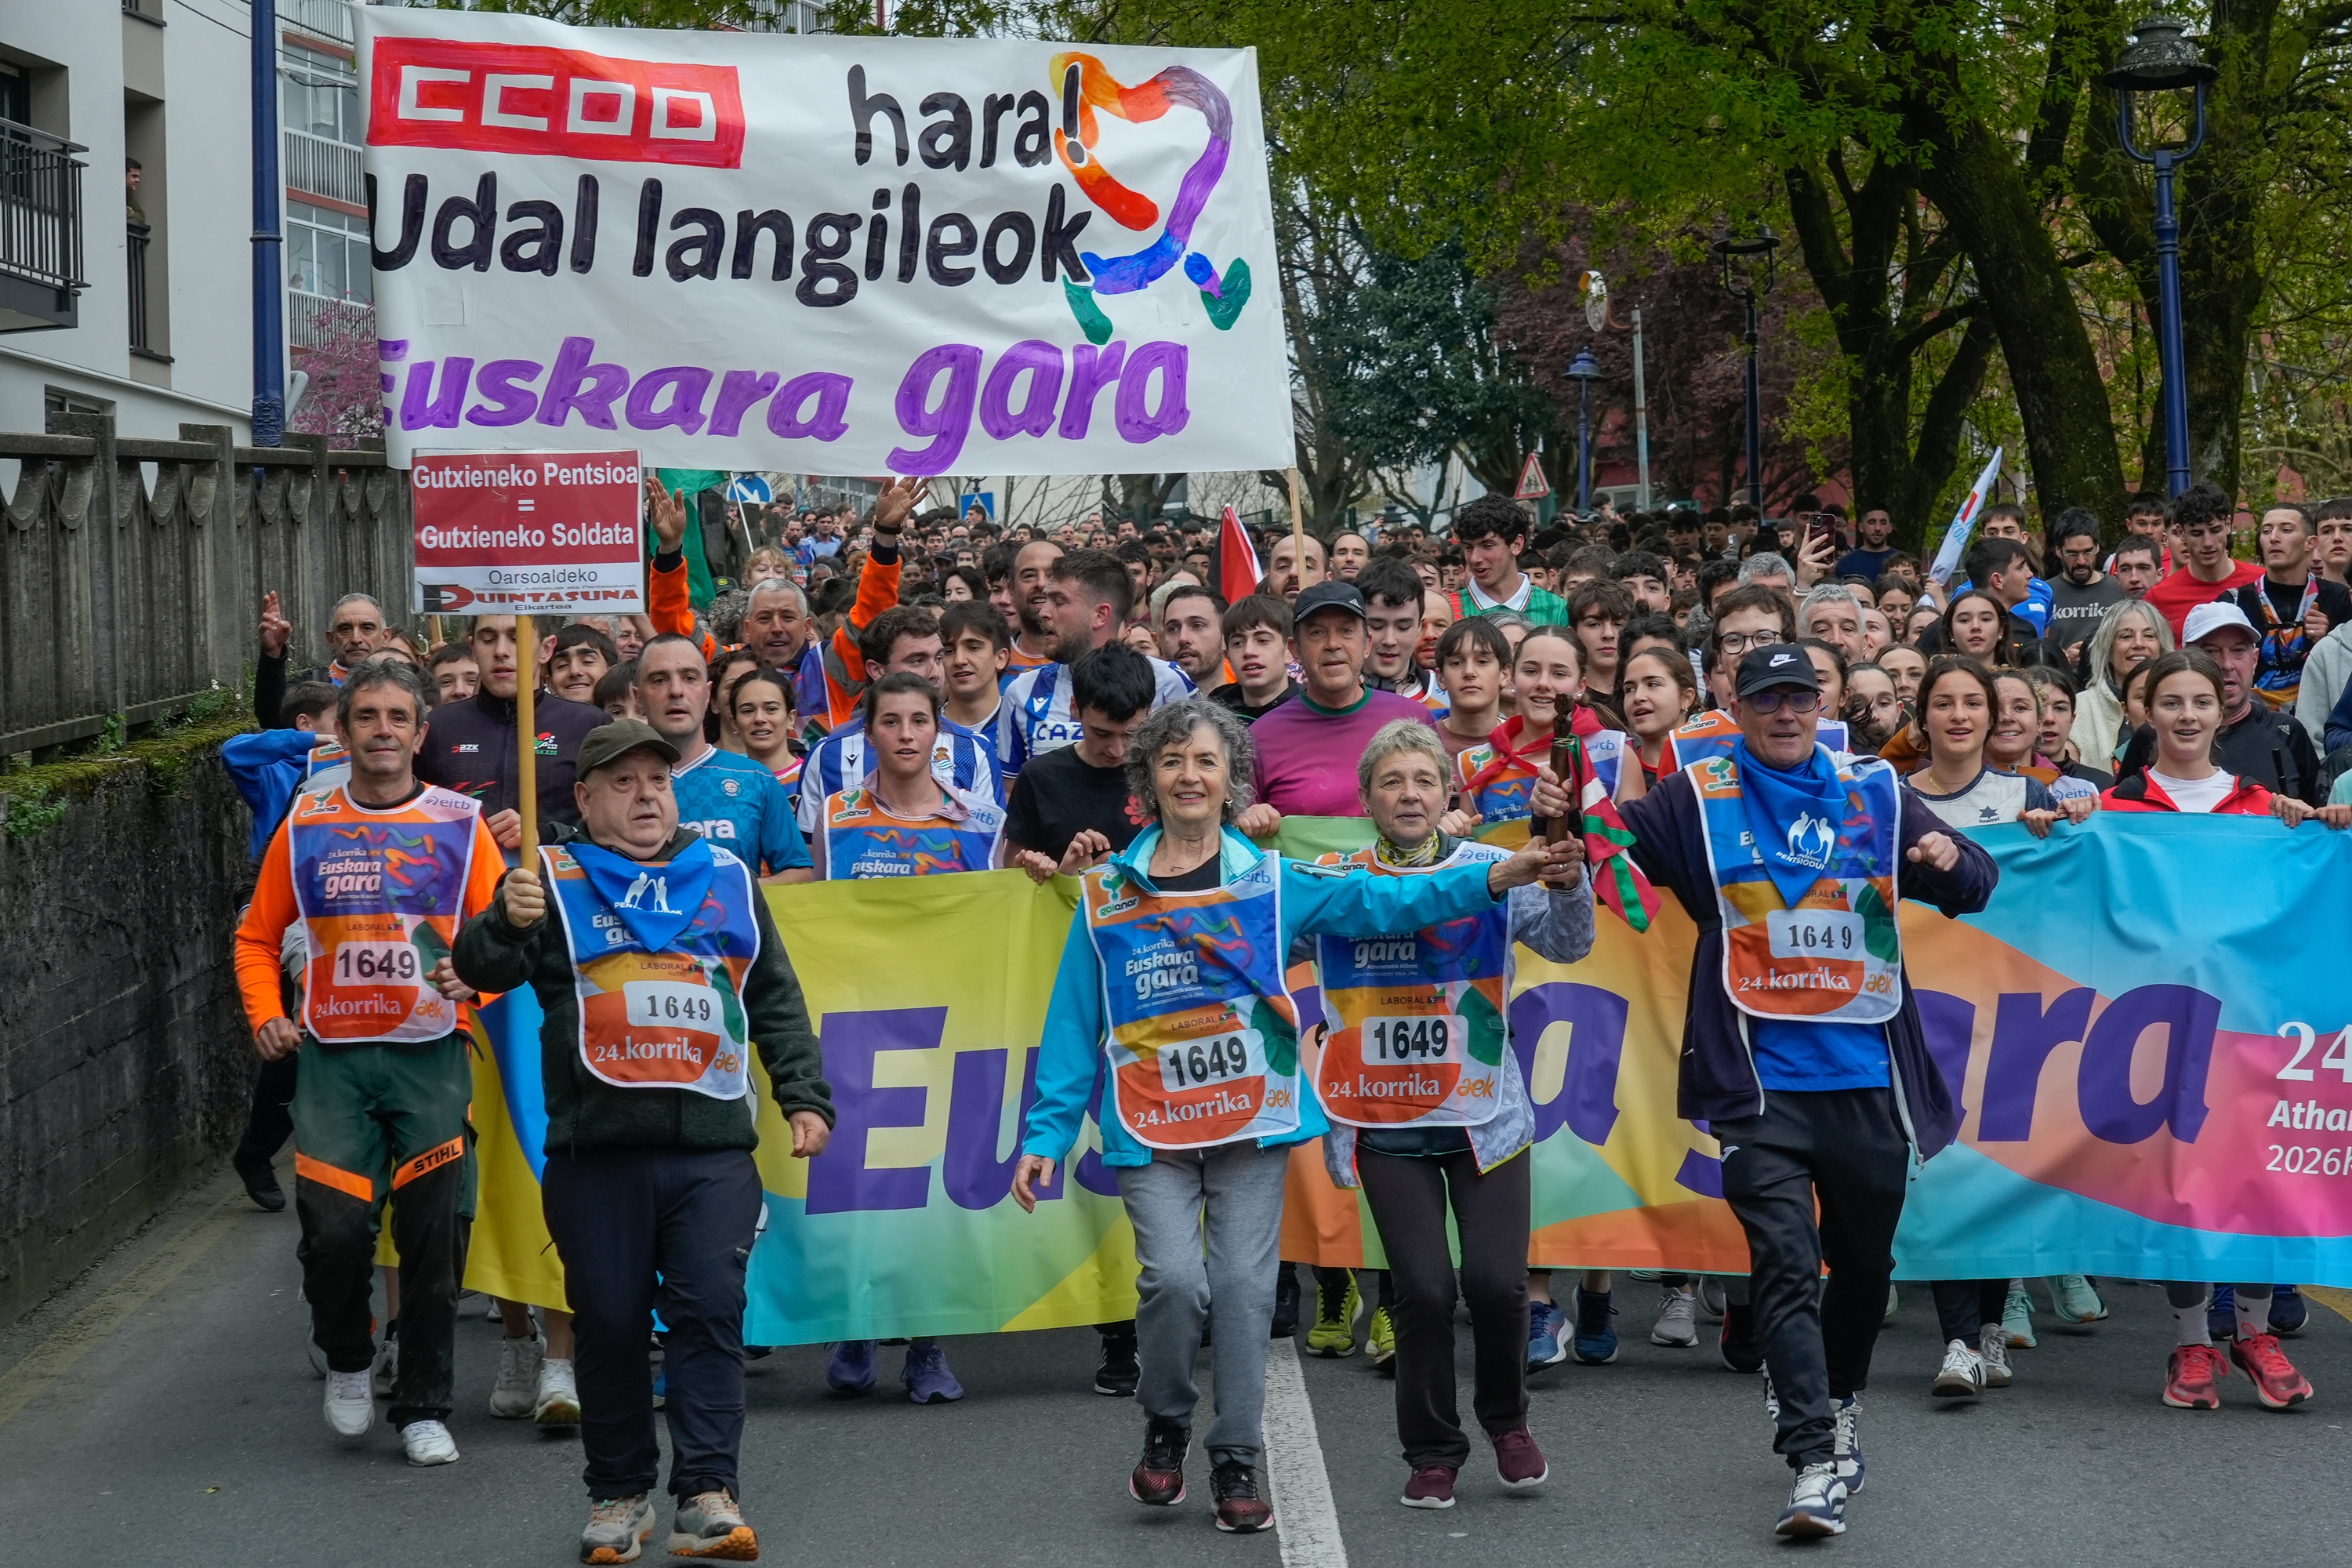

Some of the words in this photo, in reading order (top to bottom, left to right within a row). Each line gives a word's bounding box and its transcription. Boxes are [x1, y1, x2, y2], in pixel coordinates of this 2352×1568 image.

[398, 65, 717, 142] CCOO
[847, 63, 1086, 172] hara!
[365, 170, 599, 276] Udal
[632, 178, 1092, 307] langileok
[886, 339, 1190, 476] gara
[412, 463, 538, 488] Gutxieneko
[543, 461, 639, 485] Pentsioa
[421, 524, 546, 549] Gutxieneko
[551, 521, 634, 546] Soldata
[488, 568, 597, 585] Oarsoaldeko
[1682, 719, 1716, 732] goienar
[440, 797, 470, 811] eitb
[969, 808, 995, 826] eitb
[318, 858, 382, 876] Euskara
[851, 859, 912, 875] Euskara
[1242, 869, 1272, 884] eitb
[325, 874, 382, 899] gara
[1099, 898, 1138, 916] goienar
[1131, 938, 1175, 956] 24.korrika
[1788, 924, 1852, 949] 1649
[337, 949, 416, 979] 1649
[640, 962, 687, 971] LABORAL
[1125, 950, 1195, 977] Euskara
[1354, 942, 1417, 969] gara
[1134, 965, 1200, 1000] gara
[1737, 966, 1852, 992] 24.korrika
[1864, 970, 1893, 995] aek
[315, 993, 401, 1019] 24.korrika
[414, 998, 445, 1019] aek
[647, 995, 711, 1022] 1649
[1381, 996, 1425, 1005] LABORAL
[1171, 1015, 1218, 1031] LABORAL
[1374, 1019, 1449, 1059] 1649
[594, 1036, 702, 1065] 24.korrika
[713, 1049, 742, 1076] aek
[1168, 1036, 1247, 1087] 1649
[1328, 1073, 1440, 1098] 24.korrika
[1456, 1072, 1496, 1099] aek
[1134, 1091, 1253, 1129] 24.korrika
[1265, 1083, 1293, 1109] aek
[414, 1144, 461, 1174] STIHL
